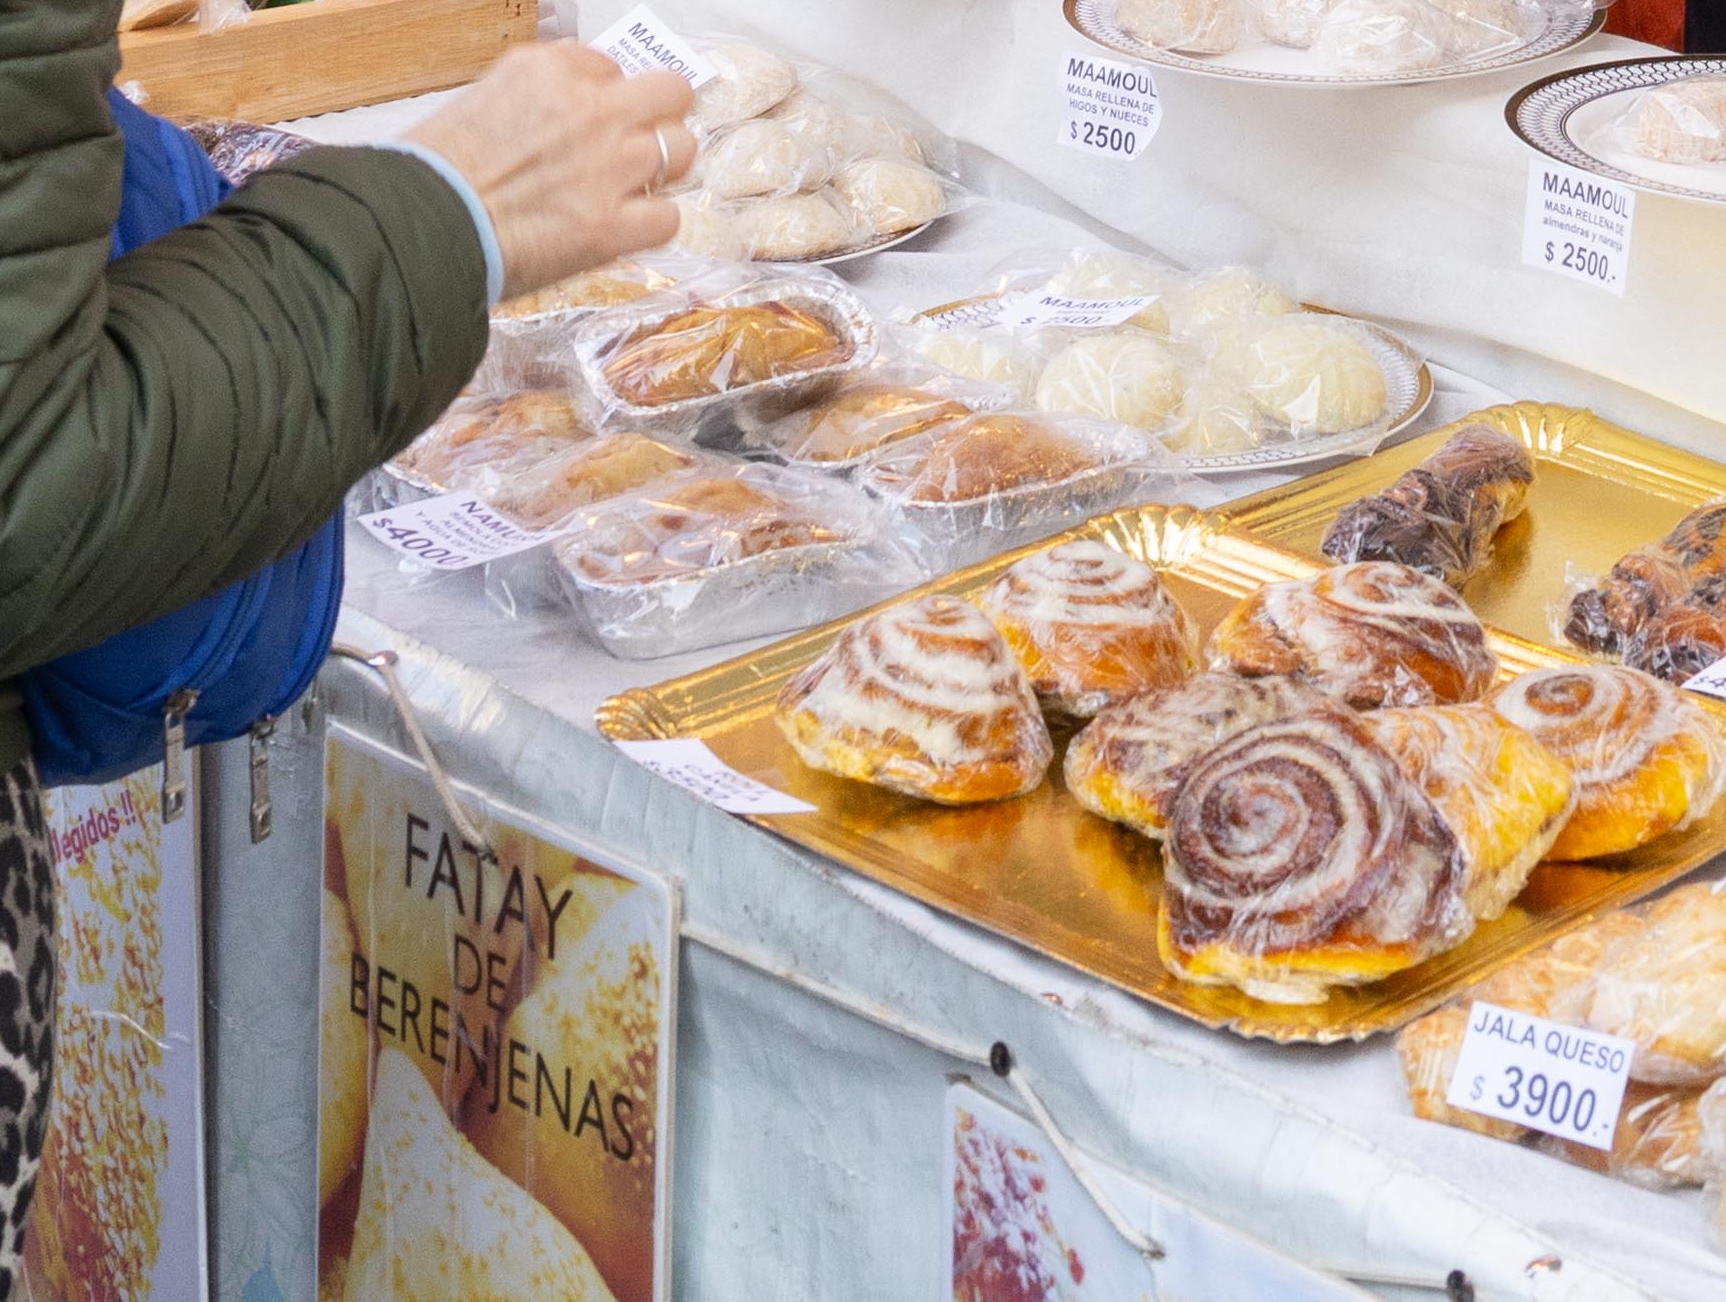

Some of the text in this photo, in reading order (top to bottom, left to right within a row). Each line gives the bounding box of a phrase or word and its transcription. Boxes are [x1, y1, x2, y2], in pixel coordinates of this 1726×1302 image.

[1067, 57, 1157, 98] MAAMOUL
[1067, 83, 1155, 115] MASA RELLENA DE
[1069, 98, 1149, 127] HIGOS Y NUECES
[1070, 120, 1078, 140] $
[1543, 171, 1628, 219] MAAMOUL
[1542, 215, 1590, 239] almendras
[1591, 232, 1598, 244] y
[1544, 199, 1625, 237] MASA RELLENA DE
[1544, 240, 1555, 264] $
[1039, 296, 1145, 309] MAAMOUL
[405, 812, 573, 960] FATAY
[453, 934, 507, 1014] DE
[350, 952, 634, 1161] BERENJENAS
[1474, 1011, 1625, 1074] JALA QUESO
[1469, 1074, 1486, 1101] $
